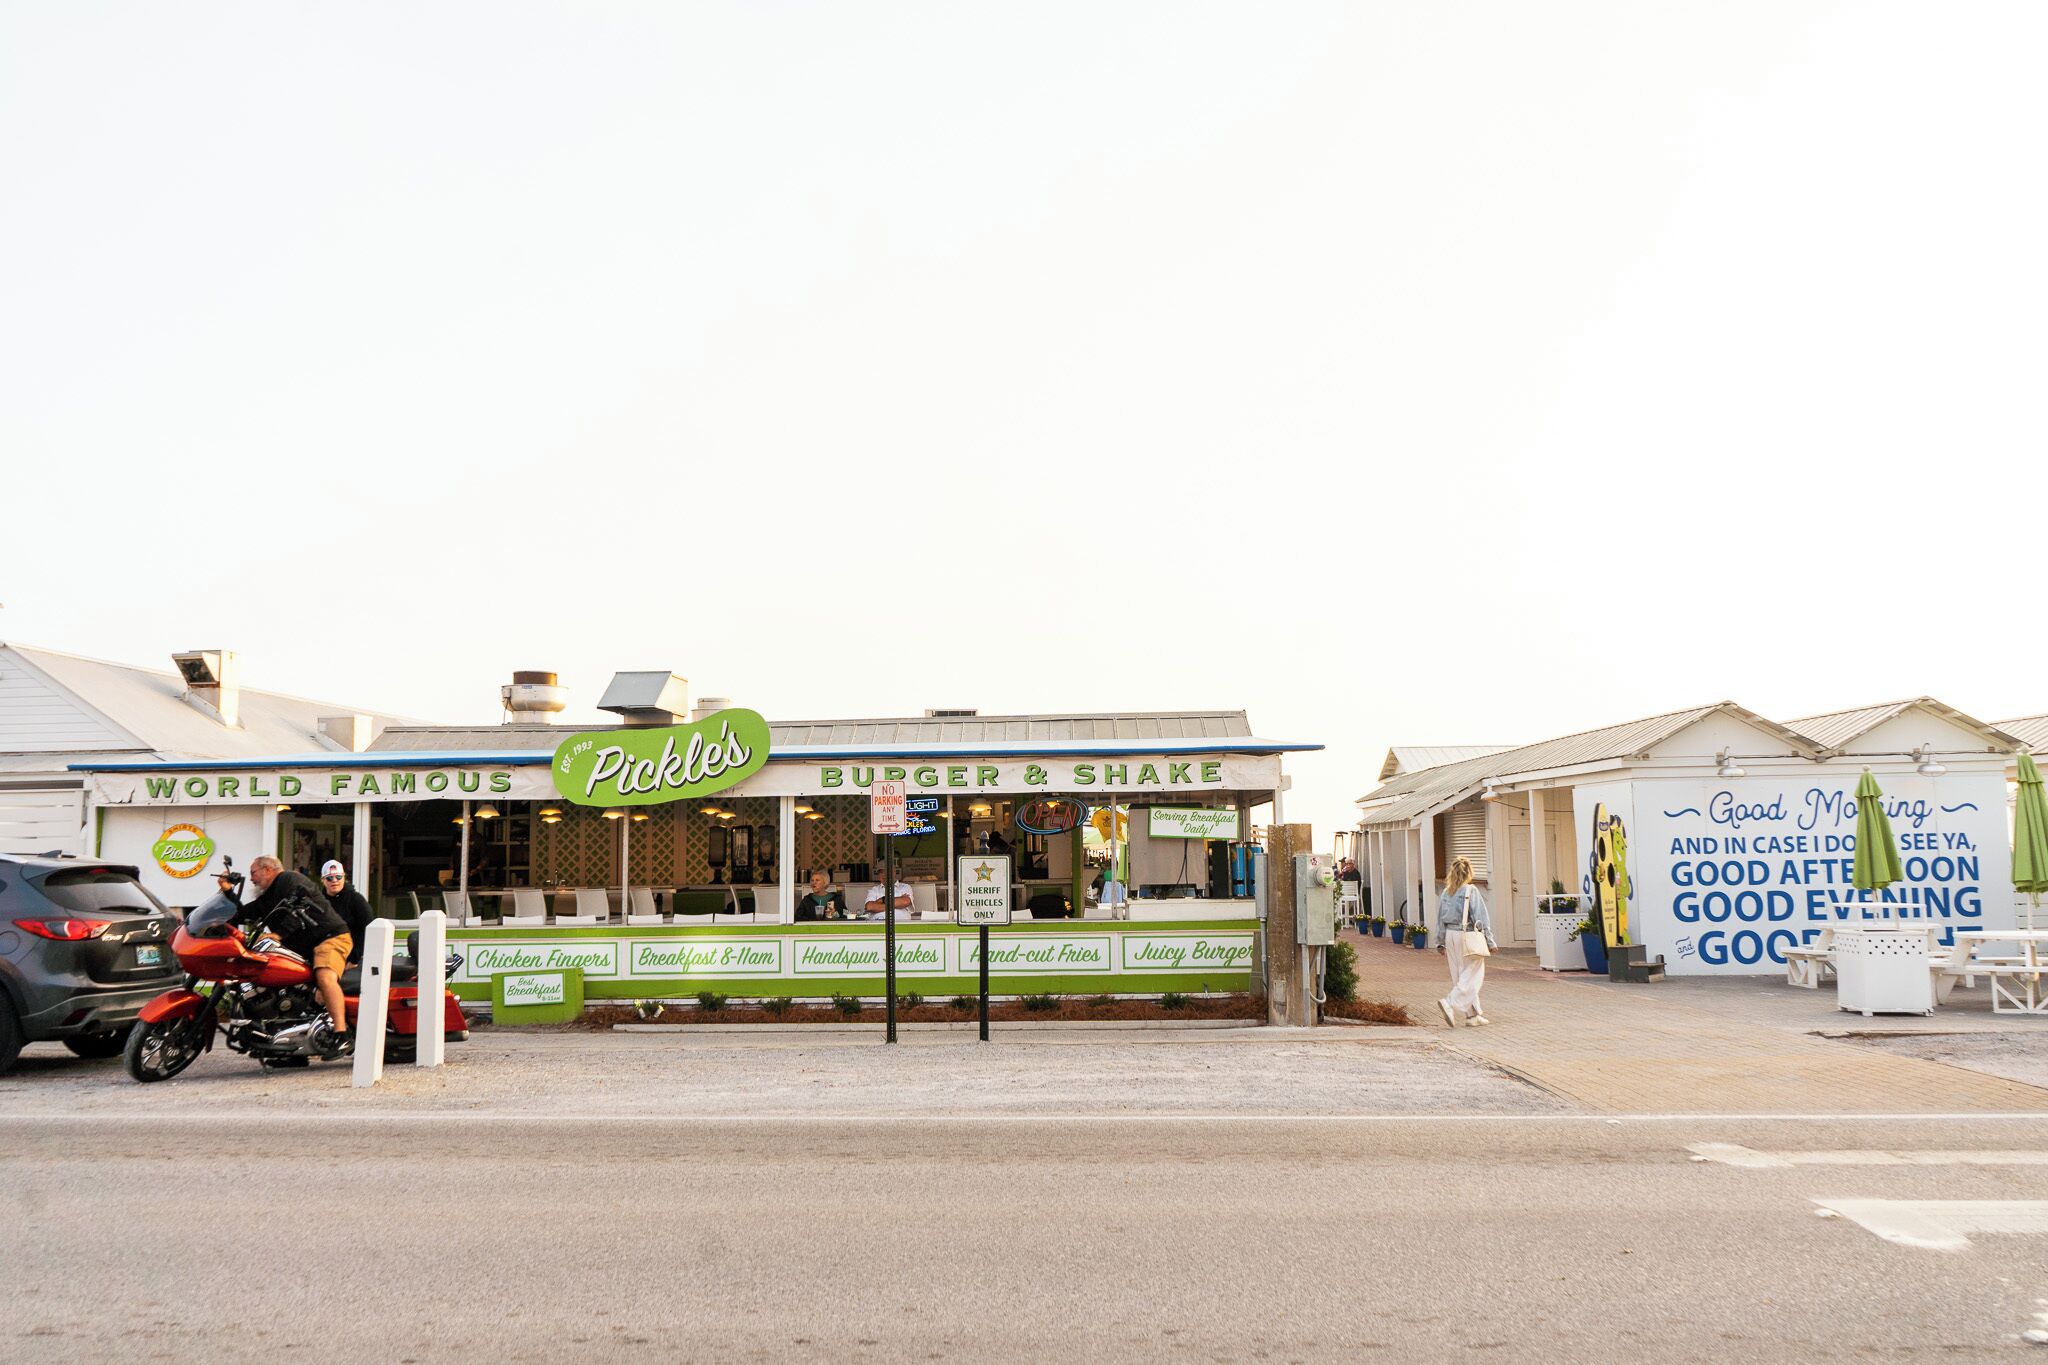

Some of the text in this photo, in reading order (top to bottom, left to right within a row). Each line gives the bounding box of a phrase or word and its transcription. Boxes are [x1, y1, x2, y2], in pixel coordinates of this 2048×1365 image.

[573, 740, 593, 756] 1993
[585, 719, 752, 797] Pickle's
[820, 761, 1222, 787] BURGER & SHAKE
[145, 771, 511, 798] WORLD FAMOUS
[881, 785, 895, 795] NO
[874, 795, 903, 806] PARKING
[908, 801, 935, 810] LIGHT
[1709, 788, 1933, 831] Good Moing
[882, 814, 897, 822] TIME
[1023, 799, 1078, 828] OPEN
[1152, 809, 1236, 827] Serving Breakfast
[1183, 823, 1214, 837] Daily!
[1670, 837, 1718, 855] AND
[1724, 836, 1746, 854] IN
[1752, 835, 1807, 854] CASE
[1813, 835, 1819, 853] I
[1901, 833, 1939, 851] SEE
[1942, 832, 1977, 852] YA,
[1671, 855, 1980, 887] GOOD AFTEOON
[967, 886, 1001, 894] SHERIFF
[965, 898, 1003, 907] VEHICLES
[1672, 890, 1794, 923] GOOD
[973, 911, 995, 919] ONLY
[475, 948, 543, 968] Chicken
[638, 946, 775, 974] Breakfast 8-11am
[801, 943, 939, 969] Handspun hakes
[1057, 943, 1102, 963] Fries
[1134, 941, 1187, 968] Juicy
[506, 983, 561, 999] Breakfast
[517, 977, 536, 986] Best
